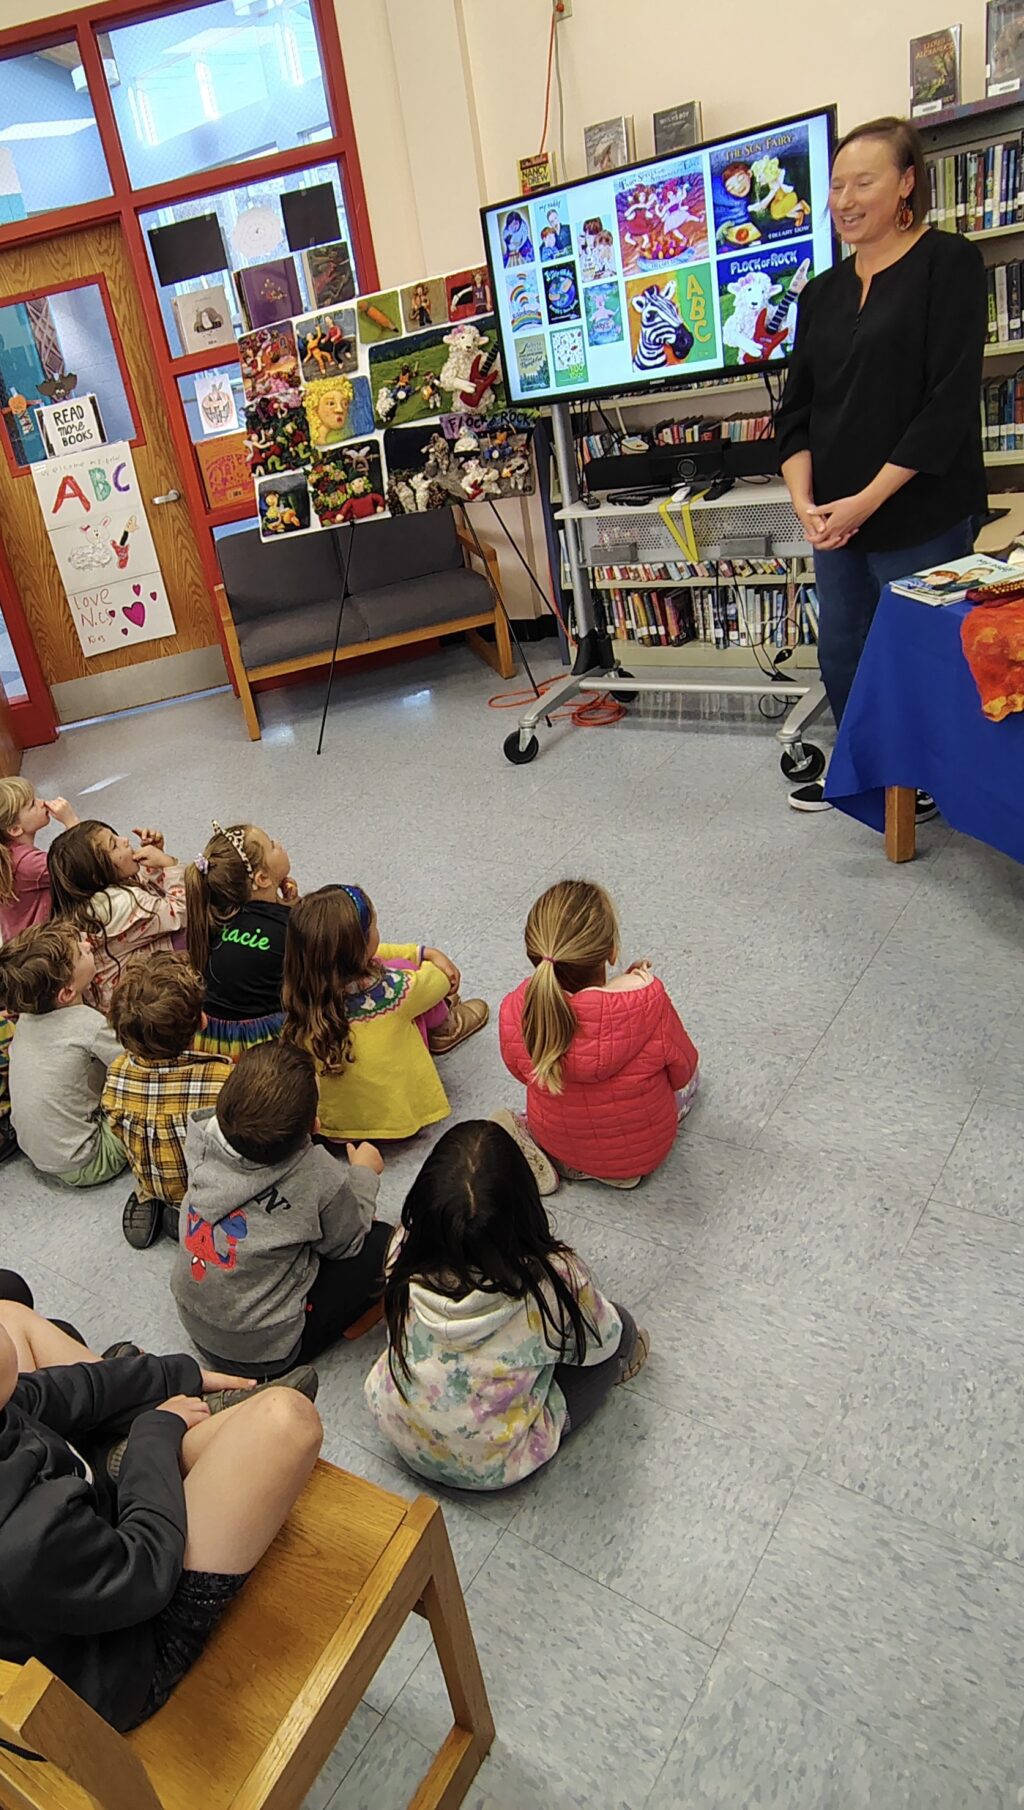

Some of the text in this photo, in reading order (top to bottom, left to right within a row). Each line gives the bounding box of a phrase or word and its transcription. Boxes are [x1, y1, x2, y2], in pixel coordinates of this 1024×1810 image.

[766, 134, 793, 150] FAIRY
[522, 165, 547, 179] NANCY
[730, 257, 762, 275] FLOCK
[770, 249, 798, 267] ROCK
[53, 405, 84, 426] READ
[57, 421, 85, 437] more
[62, 429, 93, 447] BOOKS
[221, 924, 271, 951] racie
